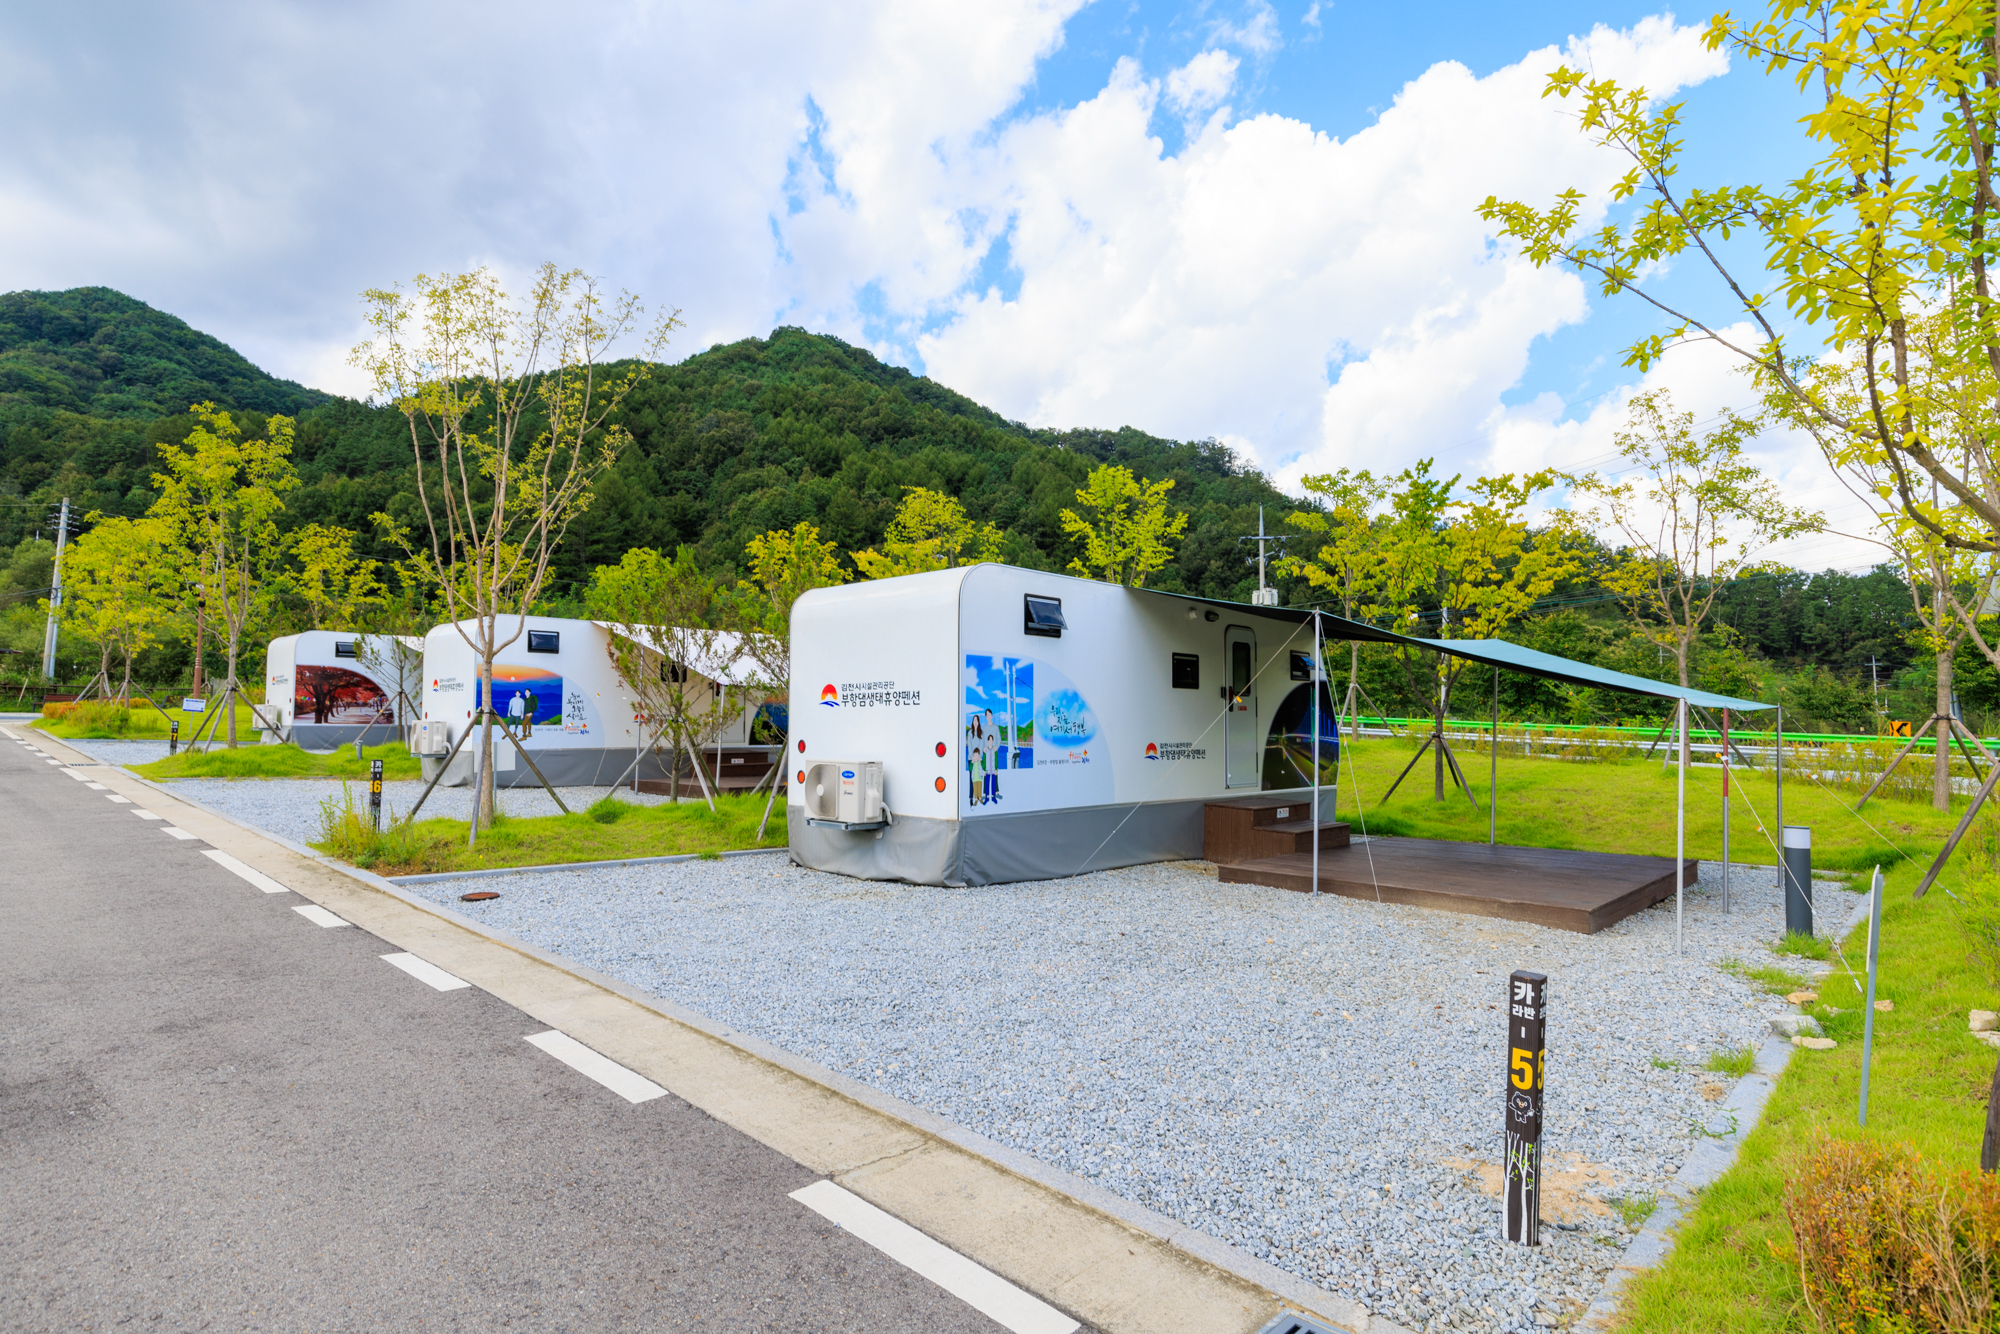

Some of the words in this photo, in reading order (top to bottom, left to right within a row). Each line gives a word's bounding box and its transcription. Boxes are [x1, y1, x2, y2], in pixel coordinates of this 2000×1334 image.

[841, 681, 895, 692] 김천시시설관리공단
[841, 690, 921, 708] 부항댐생태휴양펜션
[374, 780, 381, 793] 6
[1514, 981, 1535, 1005] 카
[1512, 1003, 1536, 1020] 라반
[1511, 1047, 1534, 1090] 5
[1537, 1048, 1545, 1090] 5
